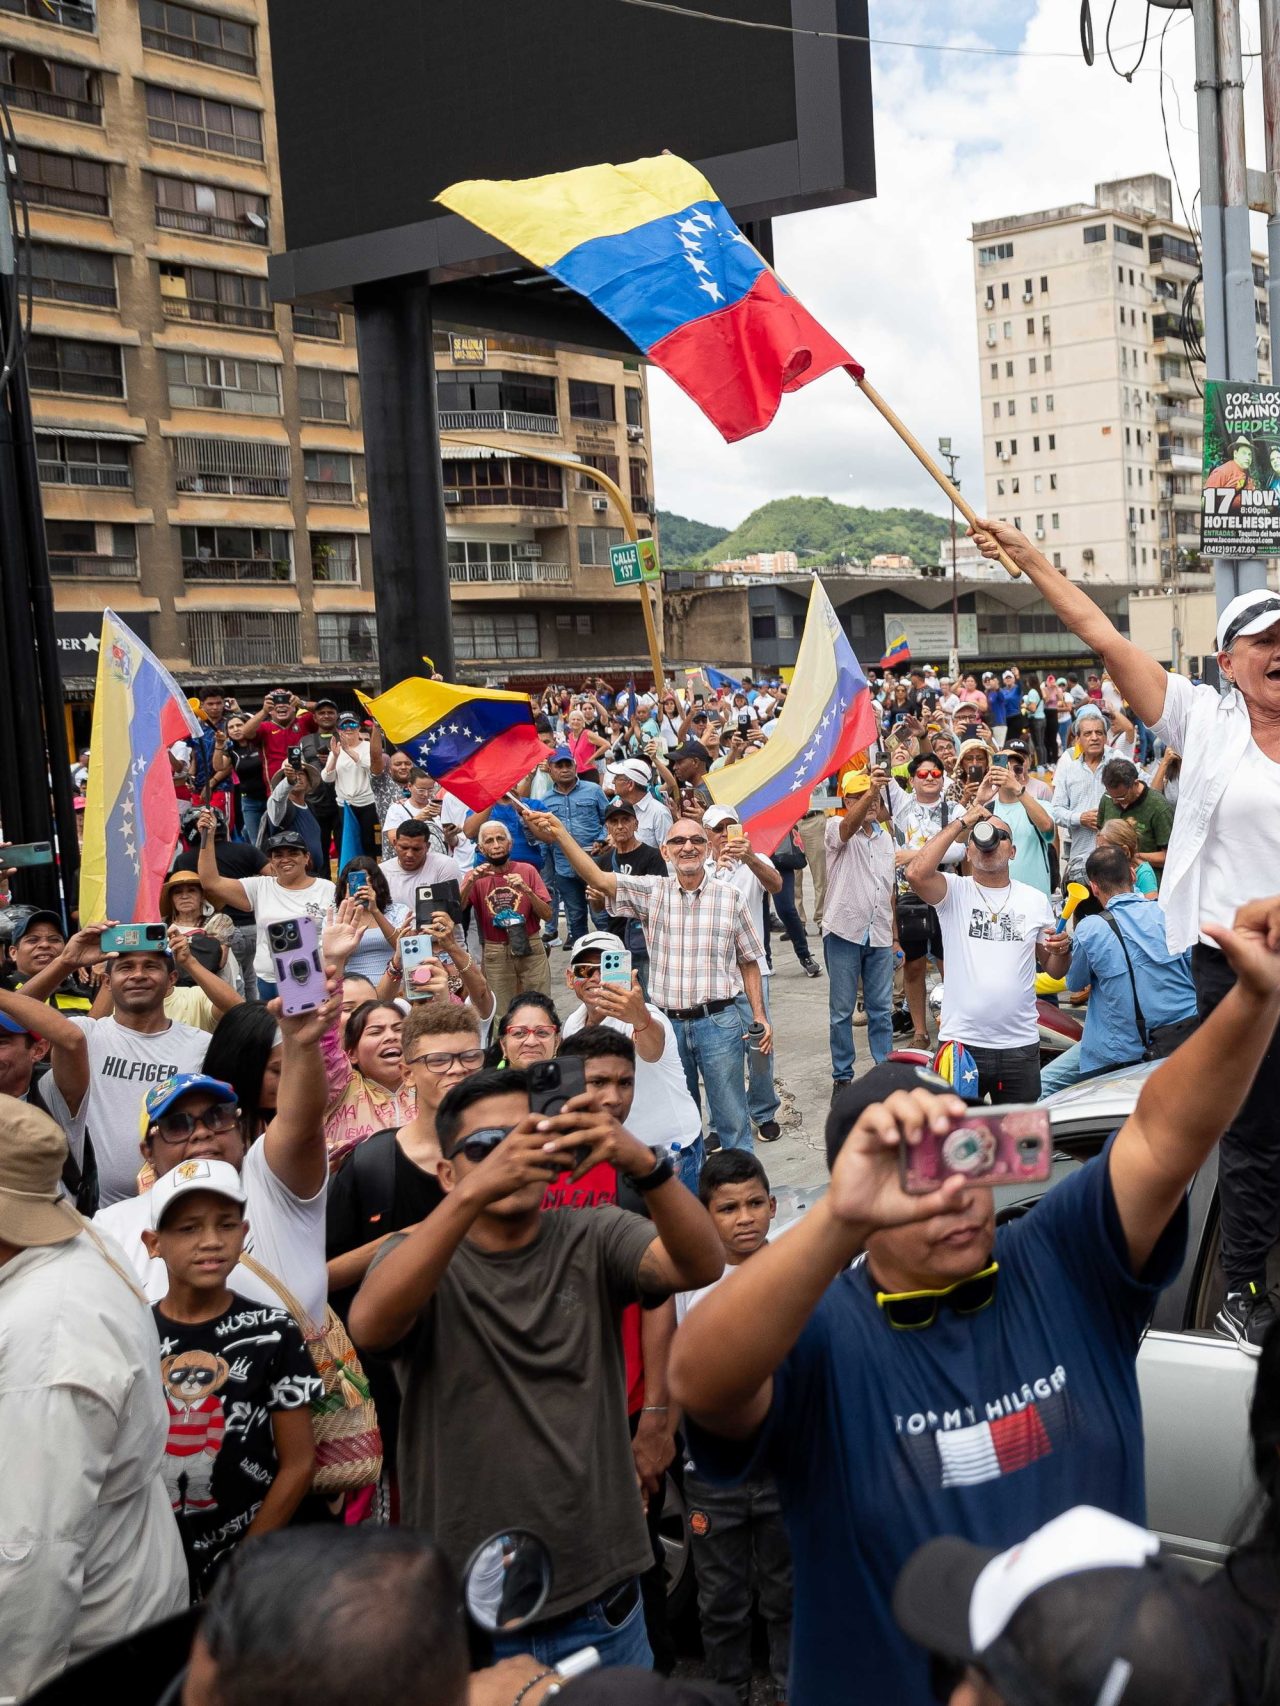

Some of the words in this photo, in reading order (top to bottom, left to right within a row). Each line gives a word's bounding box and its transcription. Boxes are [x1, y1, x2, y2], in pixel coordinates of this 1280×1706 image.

[1203, 488, 1236, 514] 17
[1204, 516, 1243, 528] HOTEL
[613, 550, 637, 566] CALLE
[620, 564, 633, 578] 137
[102, 1055, 179, 1083] HILFIGER
